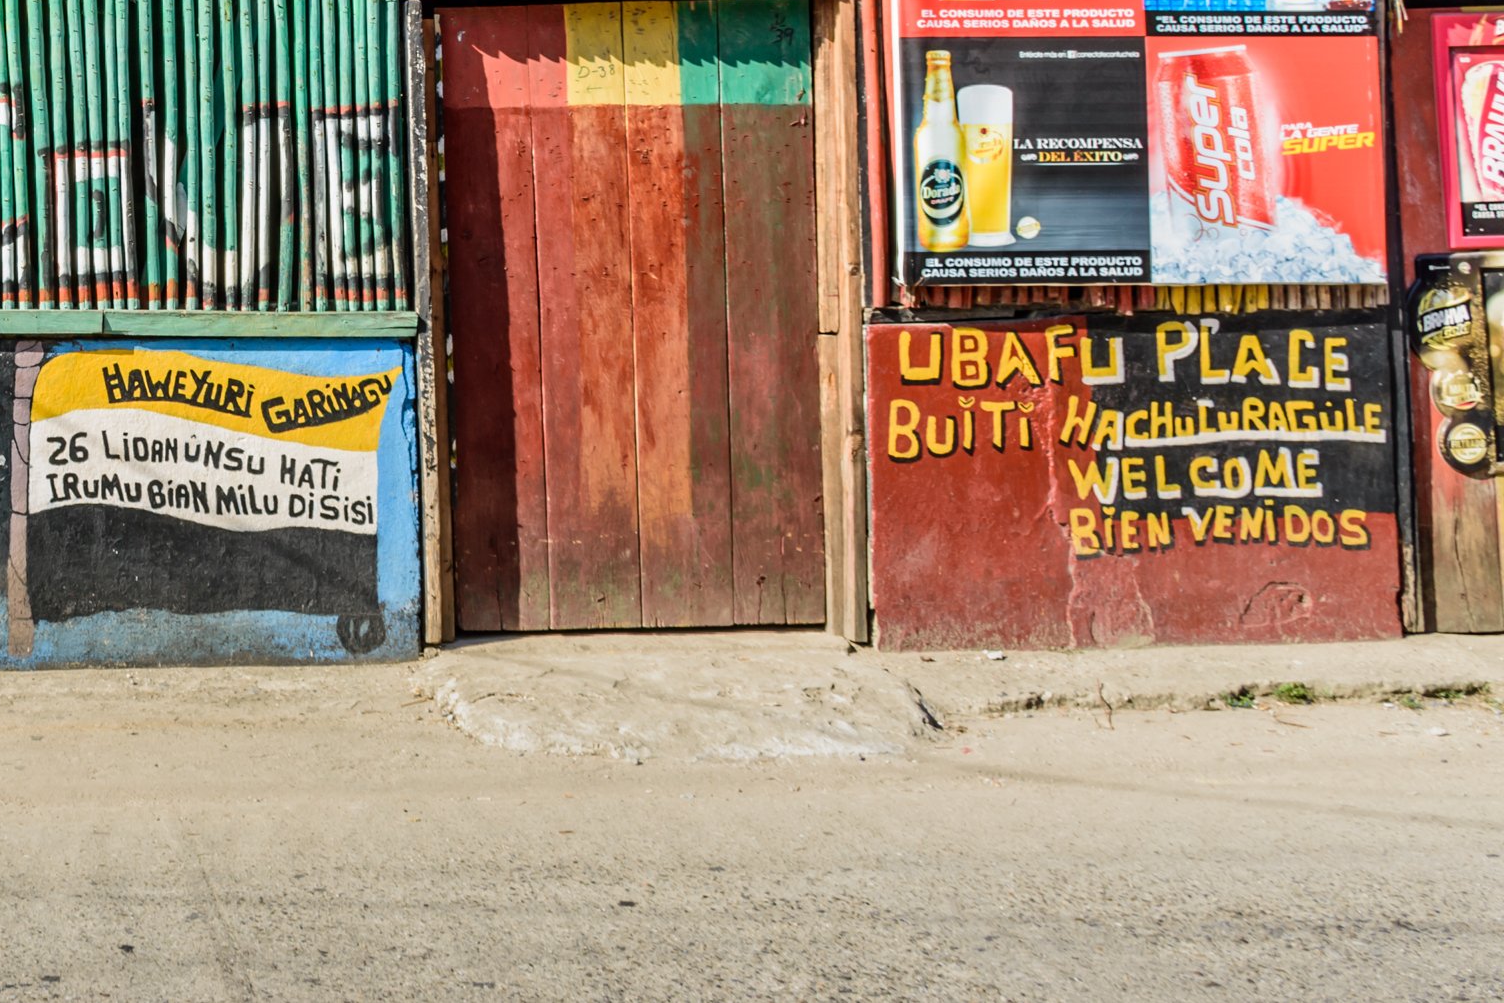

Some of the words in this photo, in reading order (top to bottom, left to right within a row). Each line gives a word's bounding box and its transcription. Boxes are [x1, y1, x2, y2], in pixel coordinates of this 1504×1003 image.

[921, 8, 936, 18] EL
[939, 8, 1004, 18] CONSUMO
[1007, 8, 1024, 18] DE
[1027, 8, 1060, 18] ESTE
[1063, 8, 1135, 18] PRODUCTO
[916, 18, 960, 28] CAUSA
[963, 18, 1009, 28] SERIOS
[1013, 17, 1057, 28] DAÑOS
[1060, 18, 1070, 28] A
[1072, 18, 1091, 28] LA
[1093, 18, 1136, 28] SALUD
[1179, 15, 1242, 24] CONSUMO
[1245, 15, 1261, 24] DE
[1264, 15, 1296, 24] ESTE
[1299, 15, 1367, 24] PRODUCTO
[1156, 24, 1197, 33] CAUSA
[1199, 24, 1244, 33] SERIOS
[1246, 23, 1289, 33] DAÑOS
[1291, 24, 1301, 33] A
[1303, 24, 1320, 33] LA
[1280, 122, 1313, 131] PARA
[1280, 129, 1302, 140] LA
[1306, 124, 1359, 138] GENTE
[1013, 138, 1034, 149] LA
[1036, 137, 1144, 149] RECOMPENSA
[1281, 132, 1375, 156] SUPER
[1038, 151, 1070, 162] DEL
[1073, 149, 1123, 162] ÉXITO
[925, 256, 943, 267] EL
[946, 256, 1011, 267] CONSUMO
[1014, 256, 1032, 267] DE
[1035, 256, 1068, 267] ESTE
[1071, 256, 1142, 267] PRODUCTO
[921, 267, 966, 278] CAUSA
[969, 267, 1017, 278] SERIOS
[1020, 266, 1064, 278] DAÑOS
[1067, 267, 1077, 278] A
[1080, 267, 1097, 278] LA
[1099, 267, 1143, 278] SALUD
[1422, 303, 1470, 333] BRAHVA
[898, 323, 1126, 390] UBAFU
[1154, 317, 1352, 392] PLACE
[46, 431, 90, 466] 26
[1067, 446, 1324, 506] WELCOME
